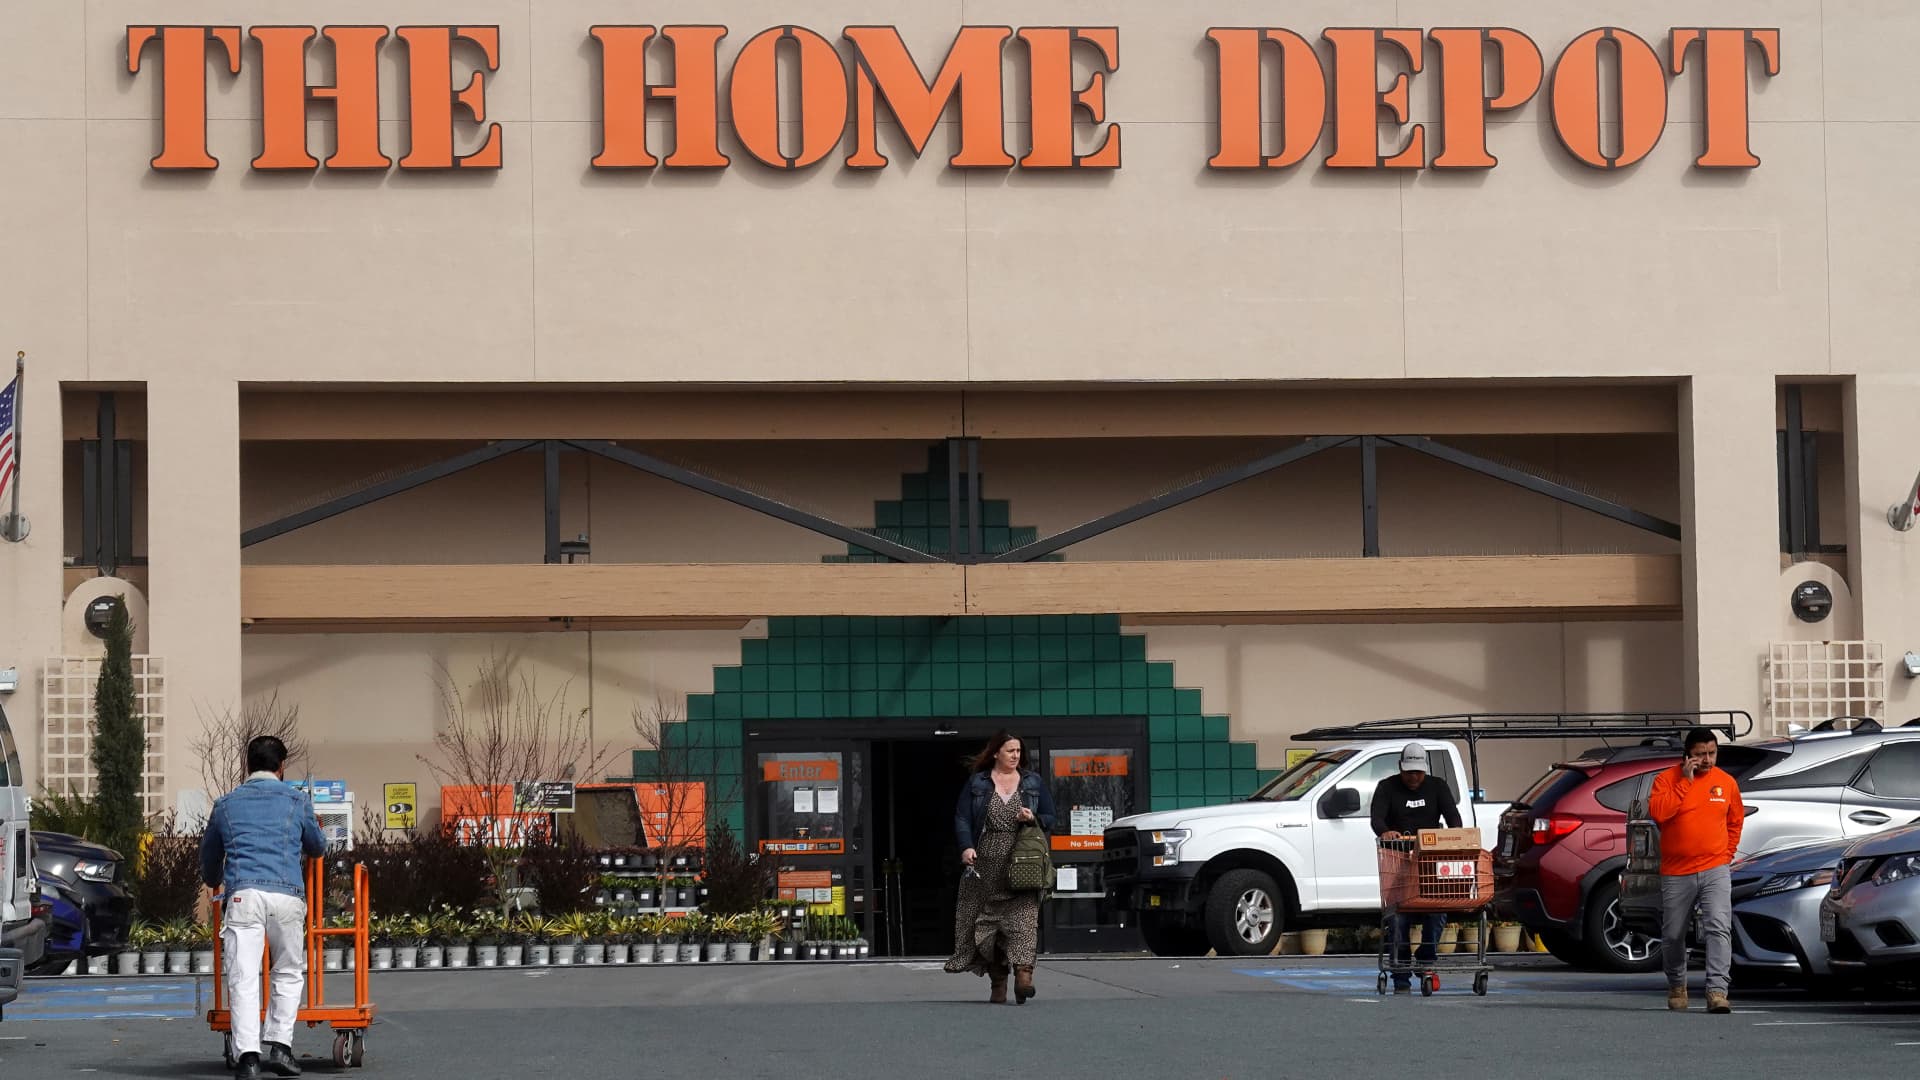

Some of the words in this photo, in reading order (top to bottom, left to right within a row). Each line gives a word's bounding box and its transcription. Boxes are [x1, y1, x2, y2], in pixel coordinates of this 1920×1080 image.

[126, 25, 503, 169] THE
[588, 24, 1122, 170] HOME
[1205, 26, 1781, 169] DEPOT
[780, 763, 823, 778] Enter
[1070, 759, 1112, 774] Enter
[1083, 840, 1104, 848] Smok
